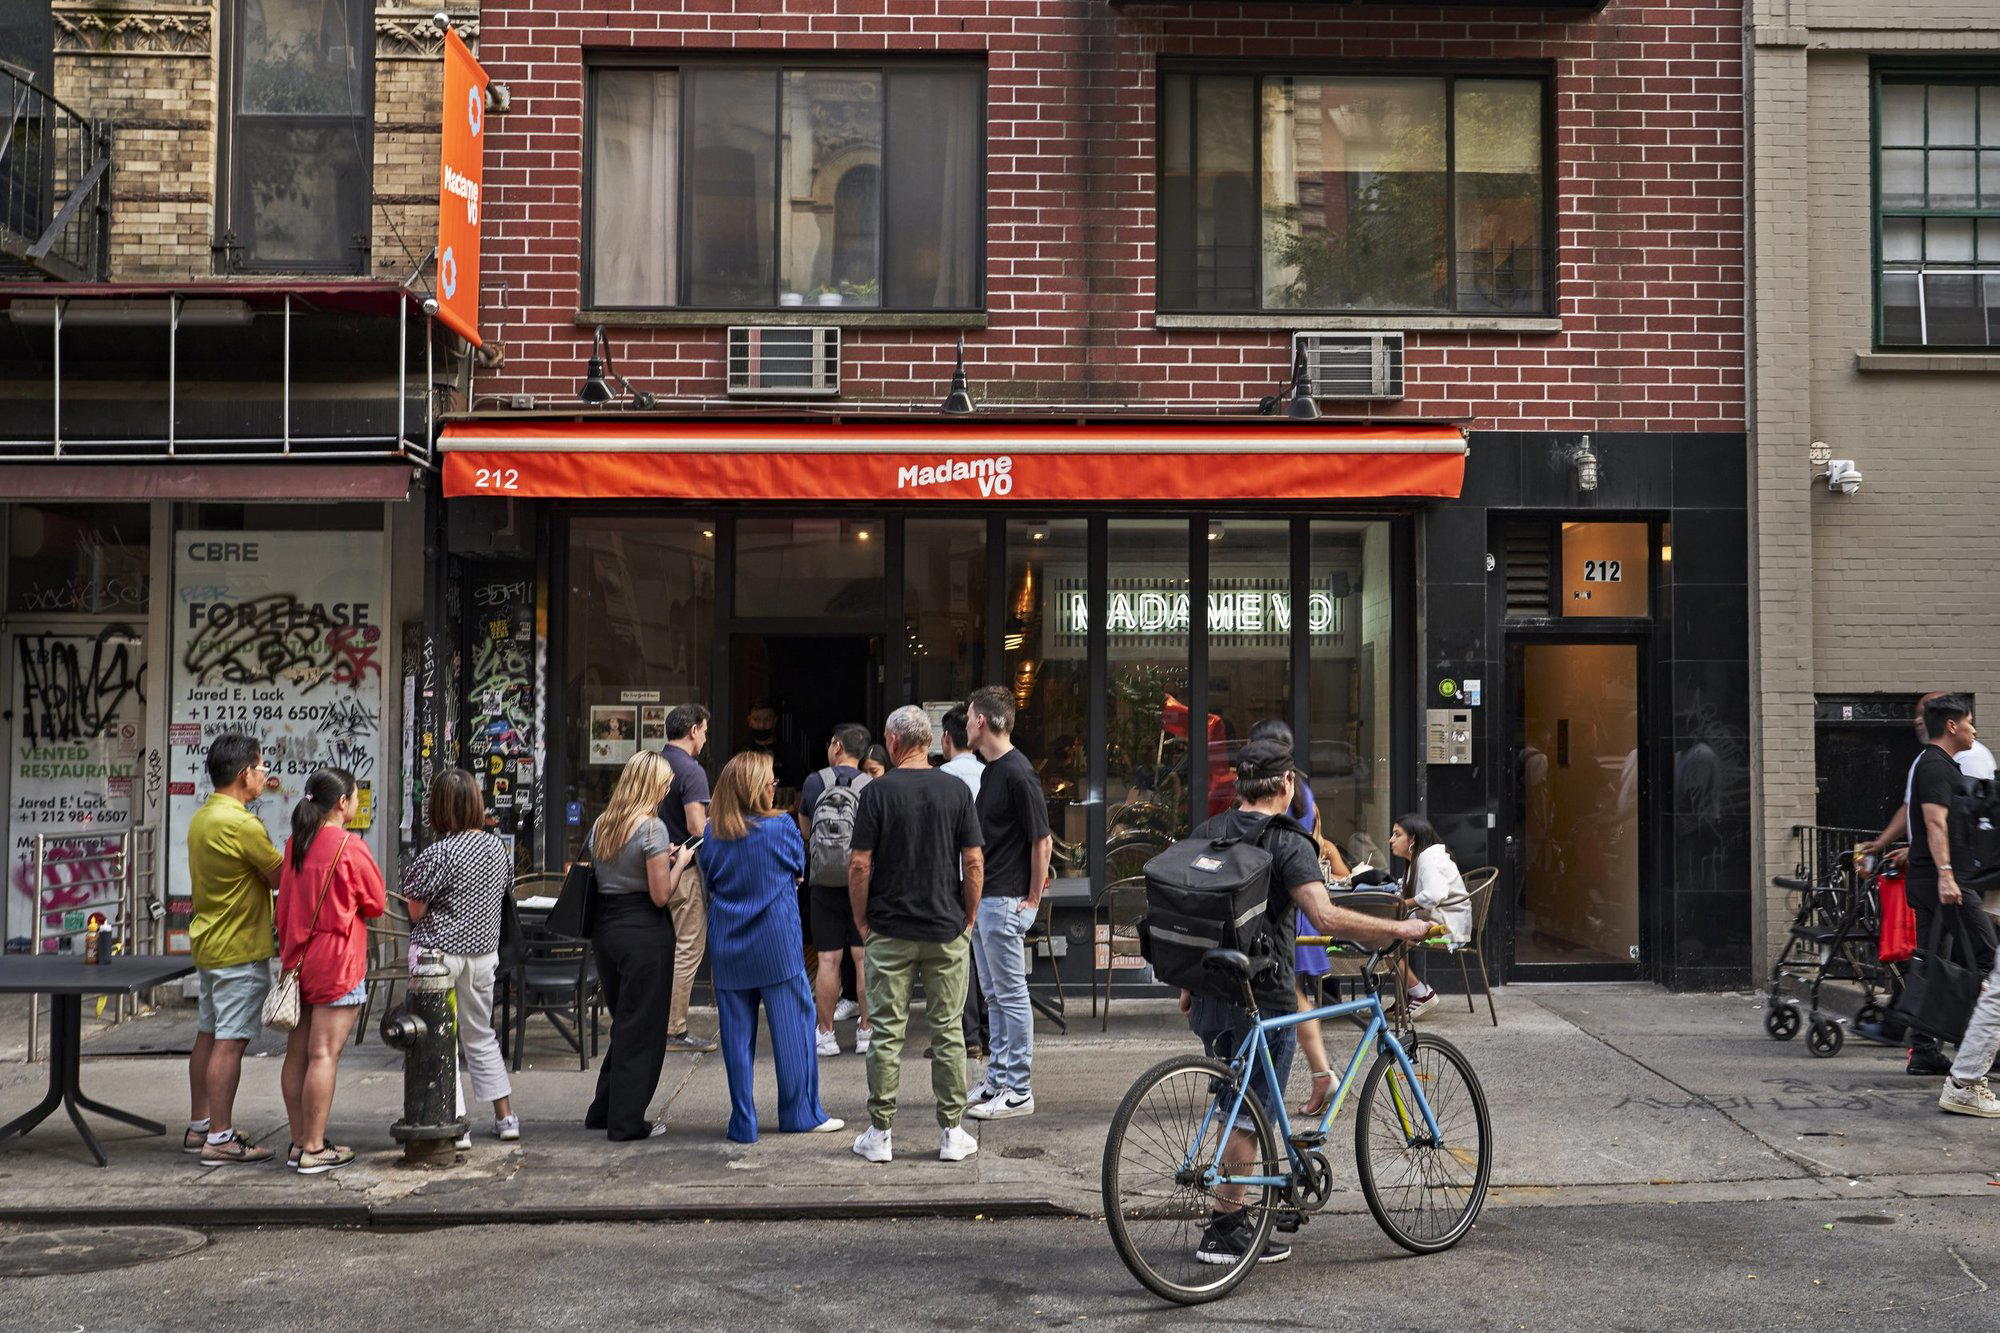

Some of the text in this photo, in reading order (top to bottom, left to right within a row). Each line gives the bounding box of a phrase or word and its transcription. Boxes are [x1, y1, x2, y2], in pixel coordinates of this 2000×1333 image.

[444, 165, 479, 199] Madame
[475, 468, 519, 490] 212
[898, 455, 1012, 488] Madame
[188, 542, 259, 562] CBRE
[1585, 560, 1620, 581] 212
[189, 602, 369, 629] FOR LEASE
[187, 688, 285, 701] Jared E. Lack
[188, 705, 329, 720] +1 212 984 6507
[21, 747, 89, 760] VENTED
[20, 764, 133, 778] RESTAURANT
[18, 796, 106, 809] Jared E. Lack
[19, 810, 128, 823] +1 212 984 6507
